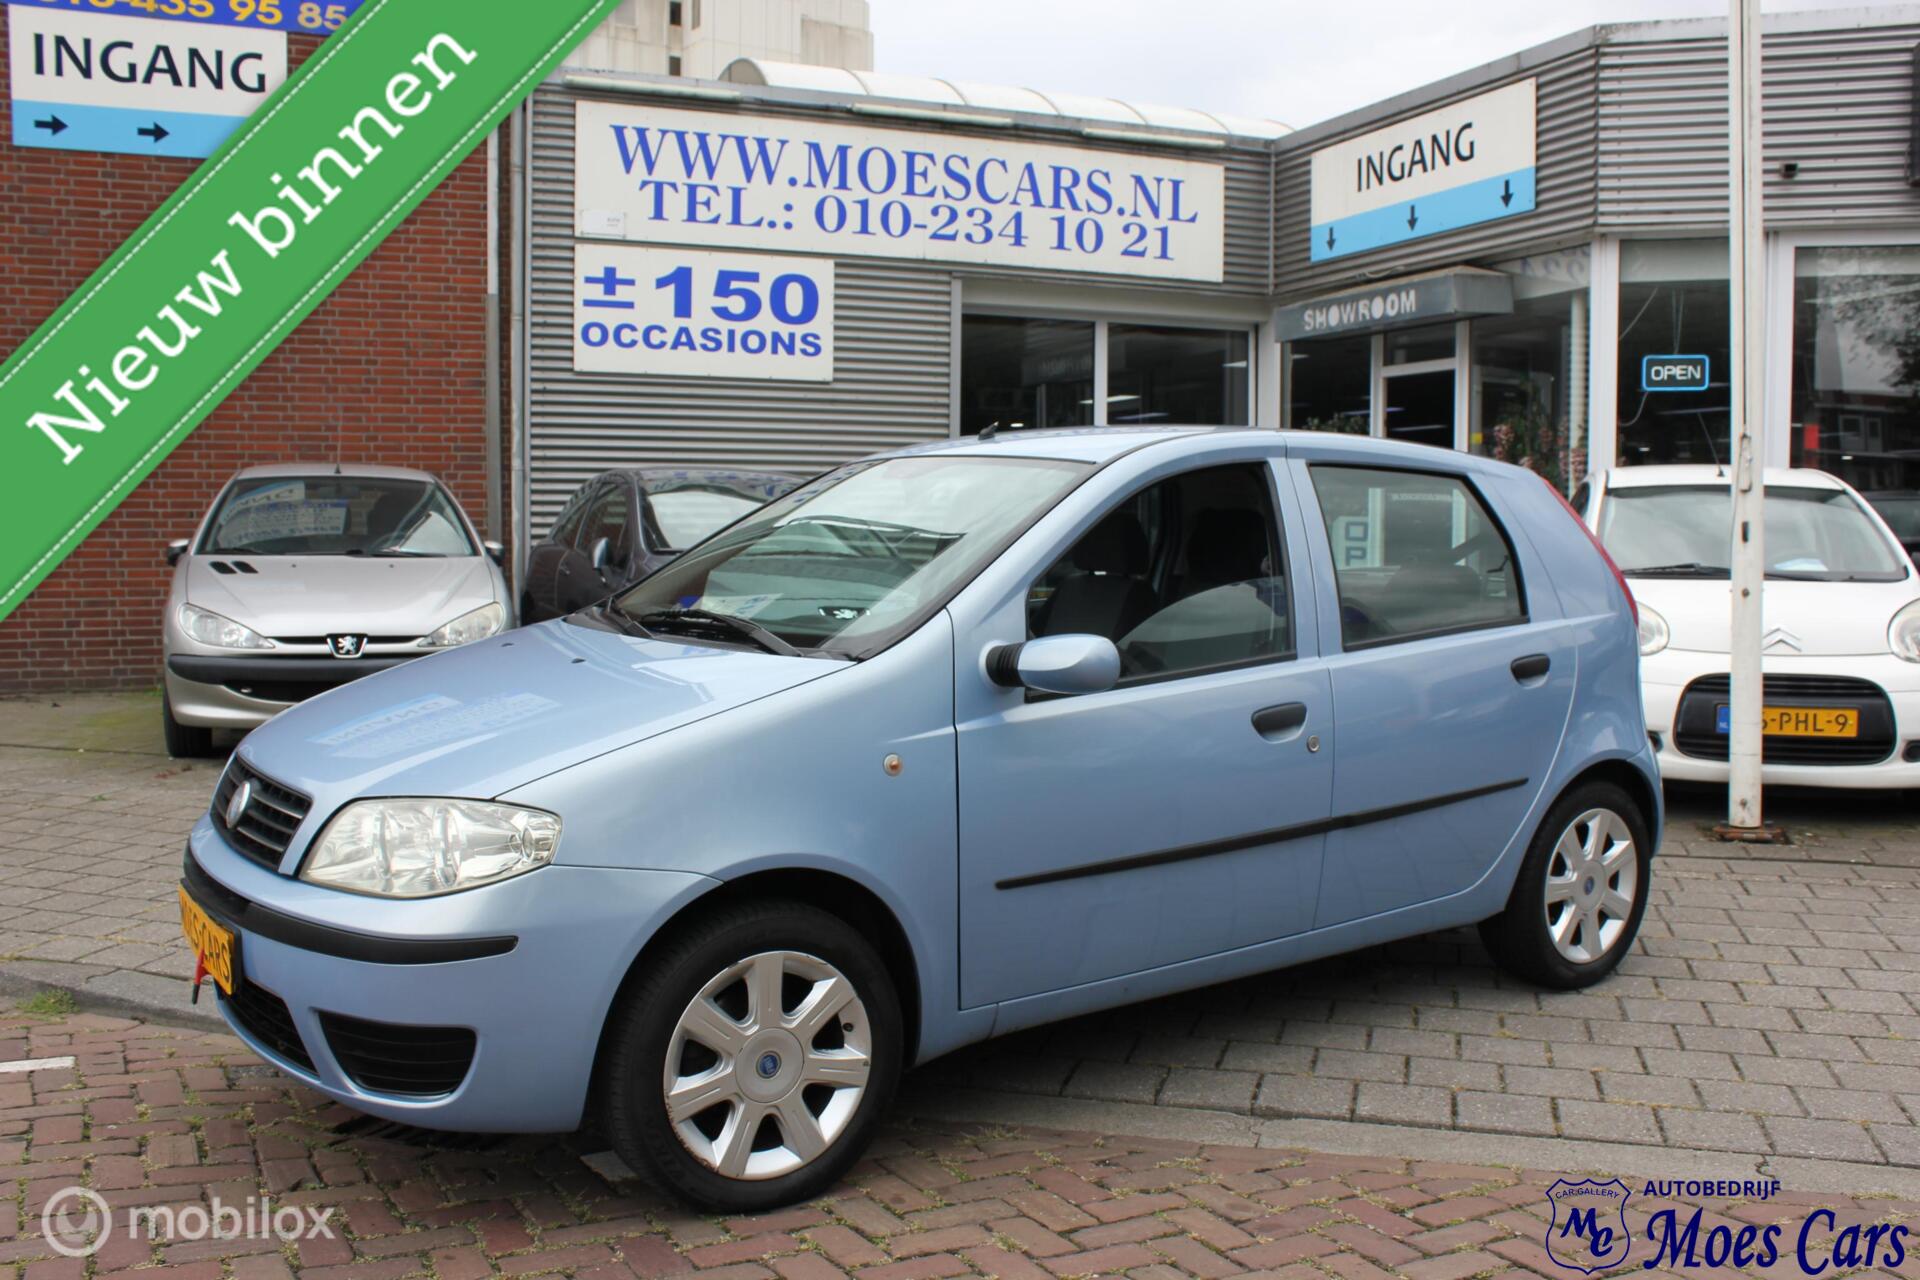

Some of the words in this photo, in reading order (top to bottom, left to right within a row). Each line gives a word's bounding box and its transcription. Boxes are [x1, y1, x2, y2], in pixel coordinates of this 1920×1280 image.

[229, 0, 283, 25] 95
[297, 2, 347, 31] 85
[33, 32, 267, 94] INGANG
[609, 124, 1199, 224] WWW.MOESCARS.NL
[1357, 121, 1475, 193] INGANG
[638, 179, 794, 230] TEL.:
[814, 194, 1029, 248] 010-234
[1049, 214, 1104, 254] 10
[1120, 221, 1176, 261] 21
[1303, 288, 1417, 331] SHOWROOM
[580, 320, 823, 358] OCCASIONS
[1650, 364, 1702, 381] OPEN
